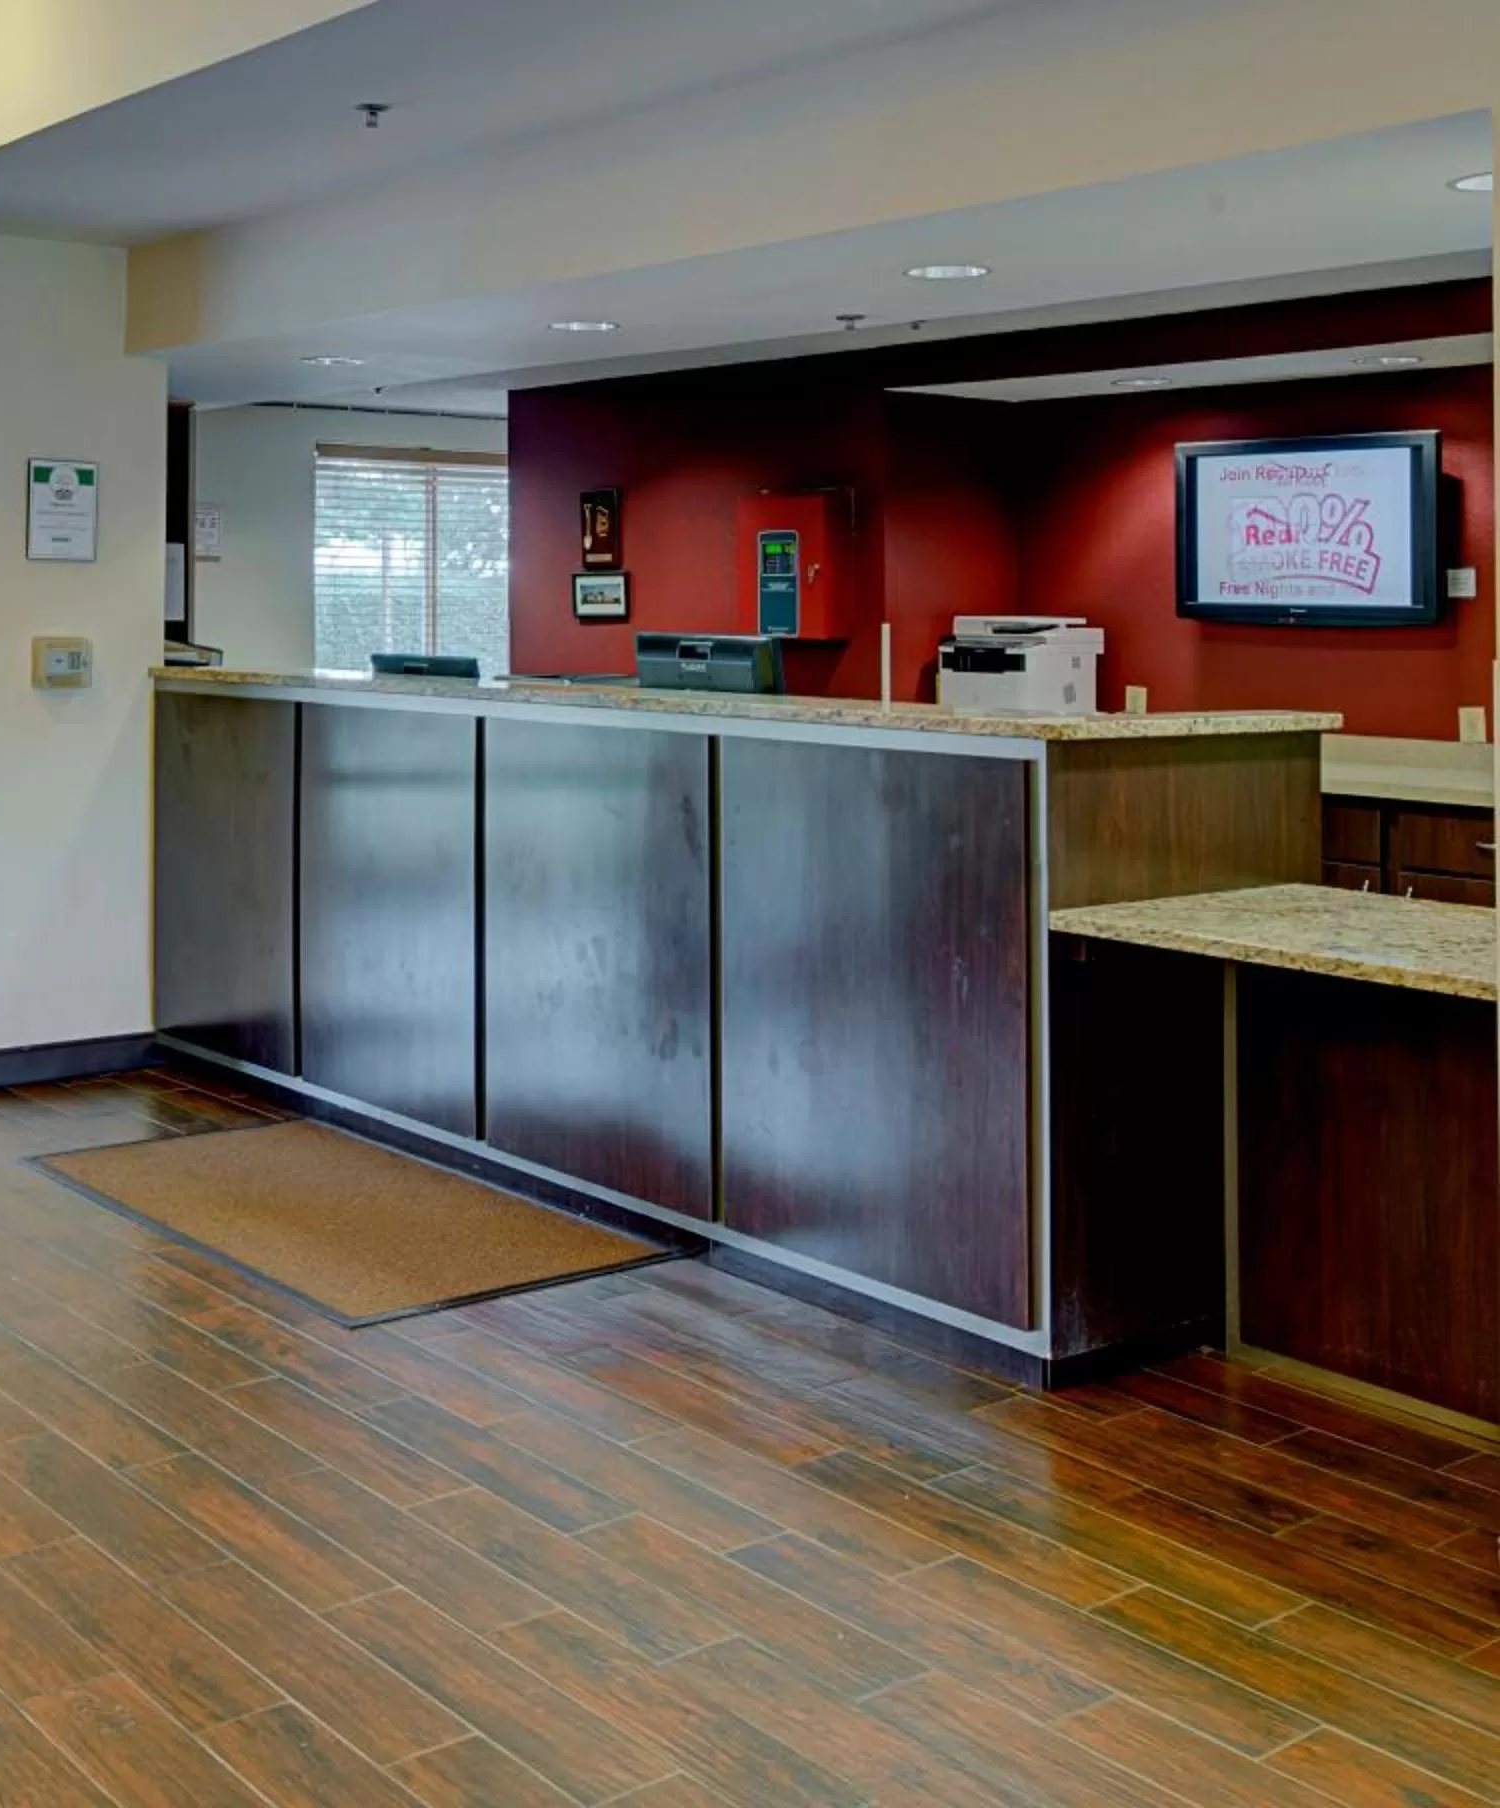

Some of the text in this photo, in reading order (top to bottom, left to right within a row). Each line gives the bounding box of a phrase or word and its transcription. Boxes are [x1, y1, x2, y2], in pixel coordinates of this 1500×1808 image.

[1219, 466, 1251, 482] Join
[1318, 549, 1370, 581] FREE
[1219, 580, 1250, 596] Free
